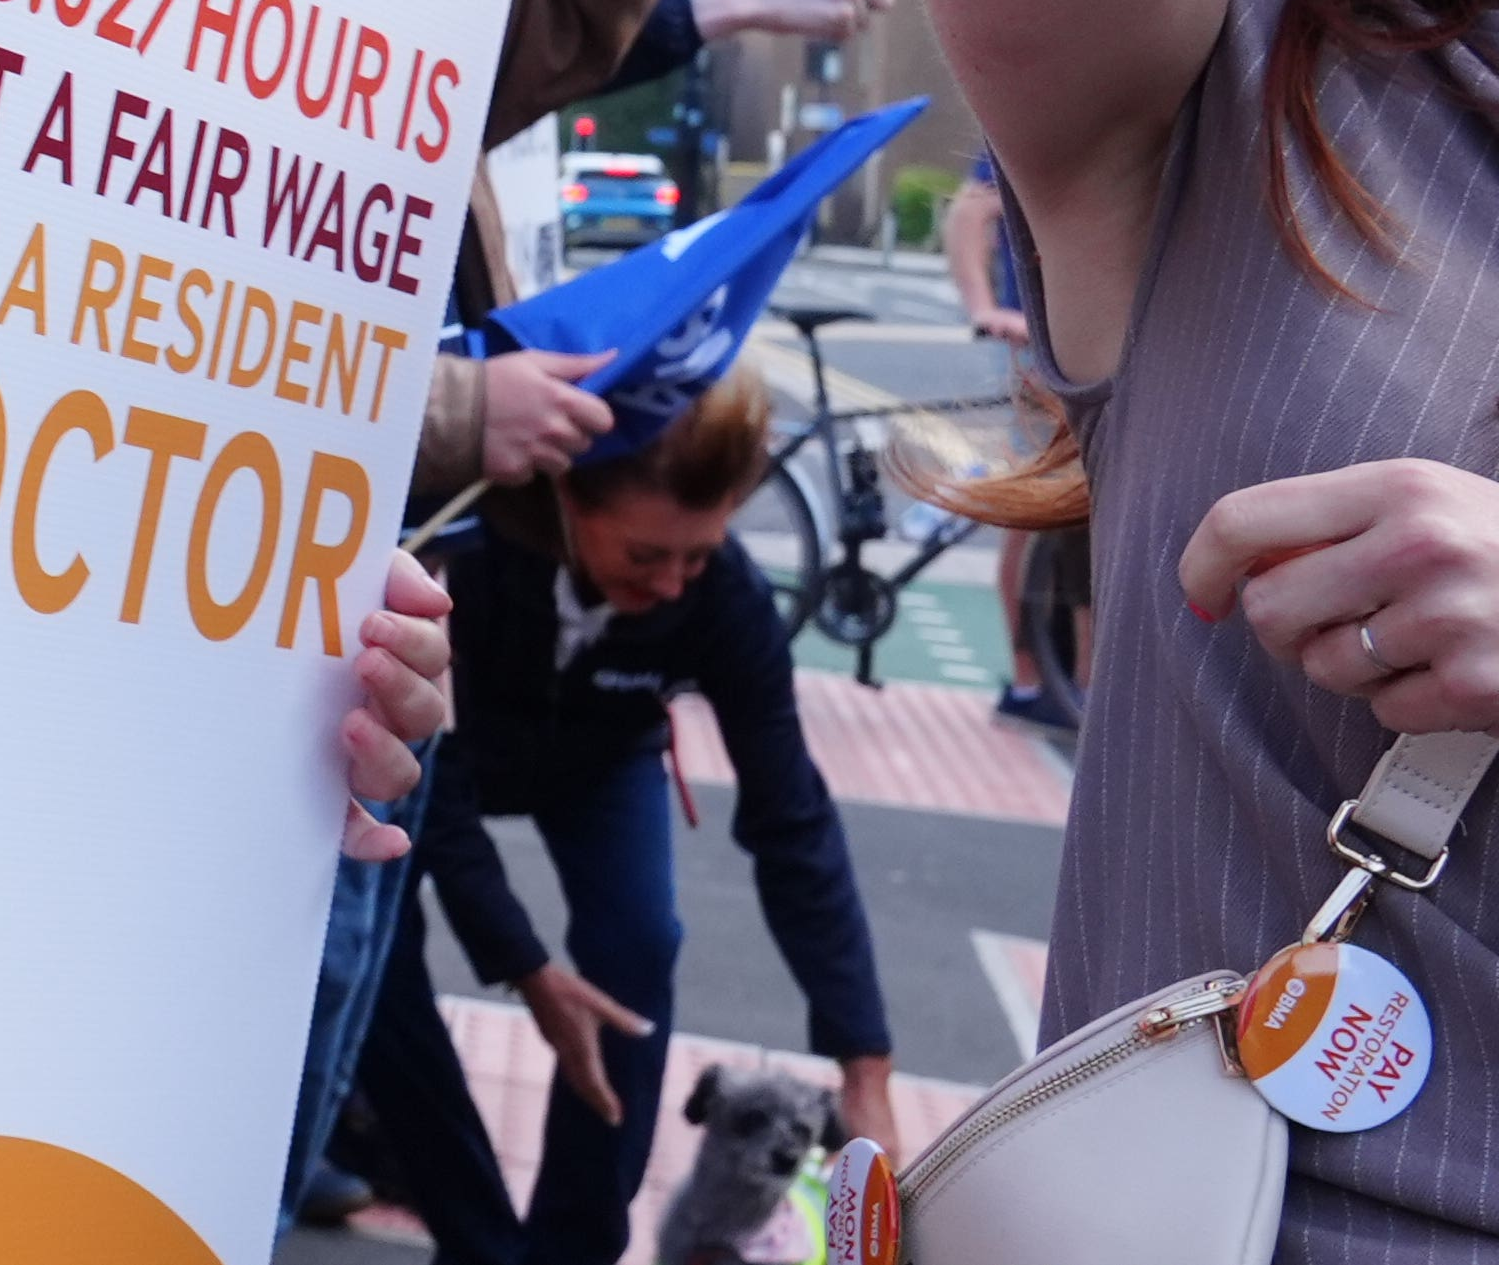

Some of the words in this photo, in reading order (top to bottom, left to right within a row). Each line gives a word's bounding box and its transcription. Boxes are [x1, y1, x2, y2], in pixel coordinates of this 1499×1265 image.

[398, 49, 461, 164] IS
[23, 71, 74, 186] A
[96, 90, 250, 239] FAIR
[262, 145, 435, 296] WAGE
[71, 238, 408, 423] RESIDENT
[1263, 992, 1297, 1030] BMA
[1314, 1003, 1373, 1082] NOW
[1320, 991, 1409, 1122] RESTORATION
[1367, 1040, 1415, 1103] PAY
[844, 1187, 857, 1261] NOW
